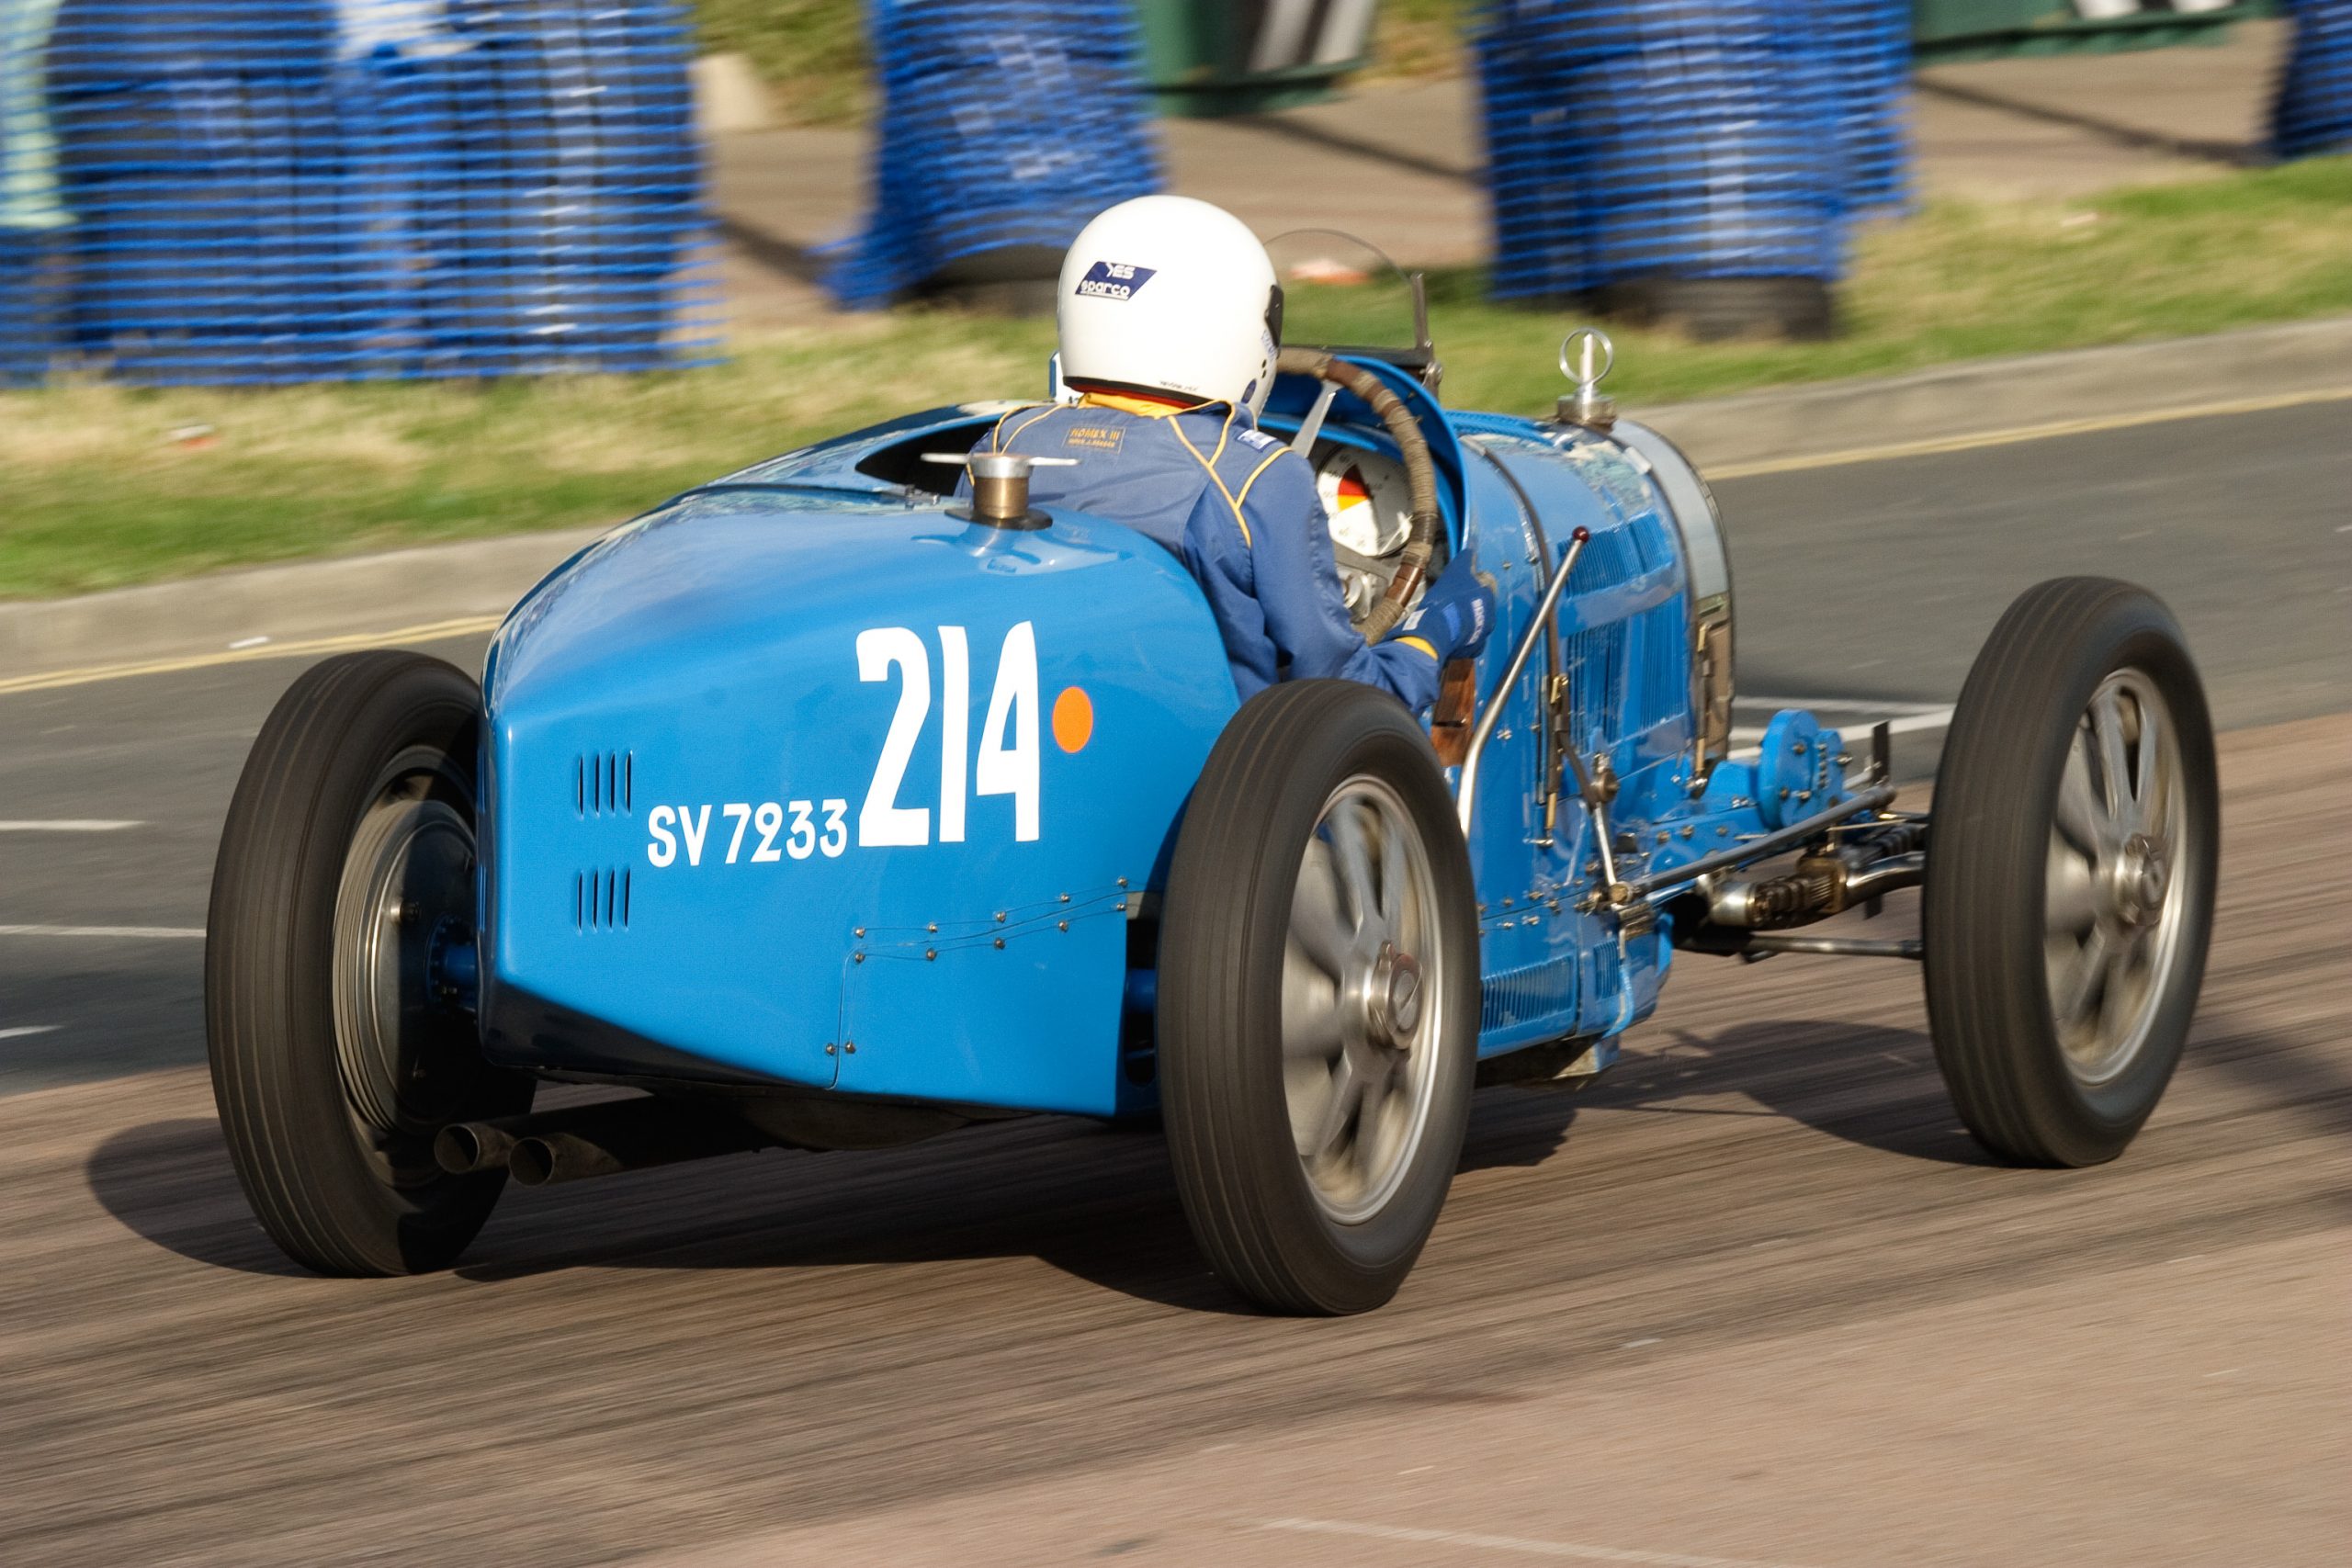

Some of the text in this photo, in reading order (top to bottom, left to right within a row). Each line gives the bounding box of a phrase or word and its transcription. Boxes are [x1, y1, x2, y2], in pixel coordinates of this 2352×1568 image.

[1080, 279, 1131, 297] sparco
[1105, 262, 1136, 279] YES
[855, 620, 1040, 847] 214
[647, 797, 849, 867] SV 7233
